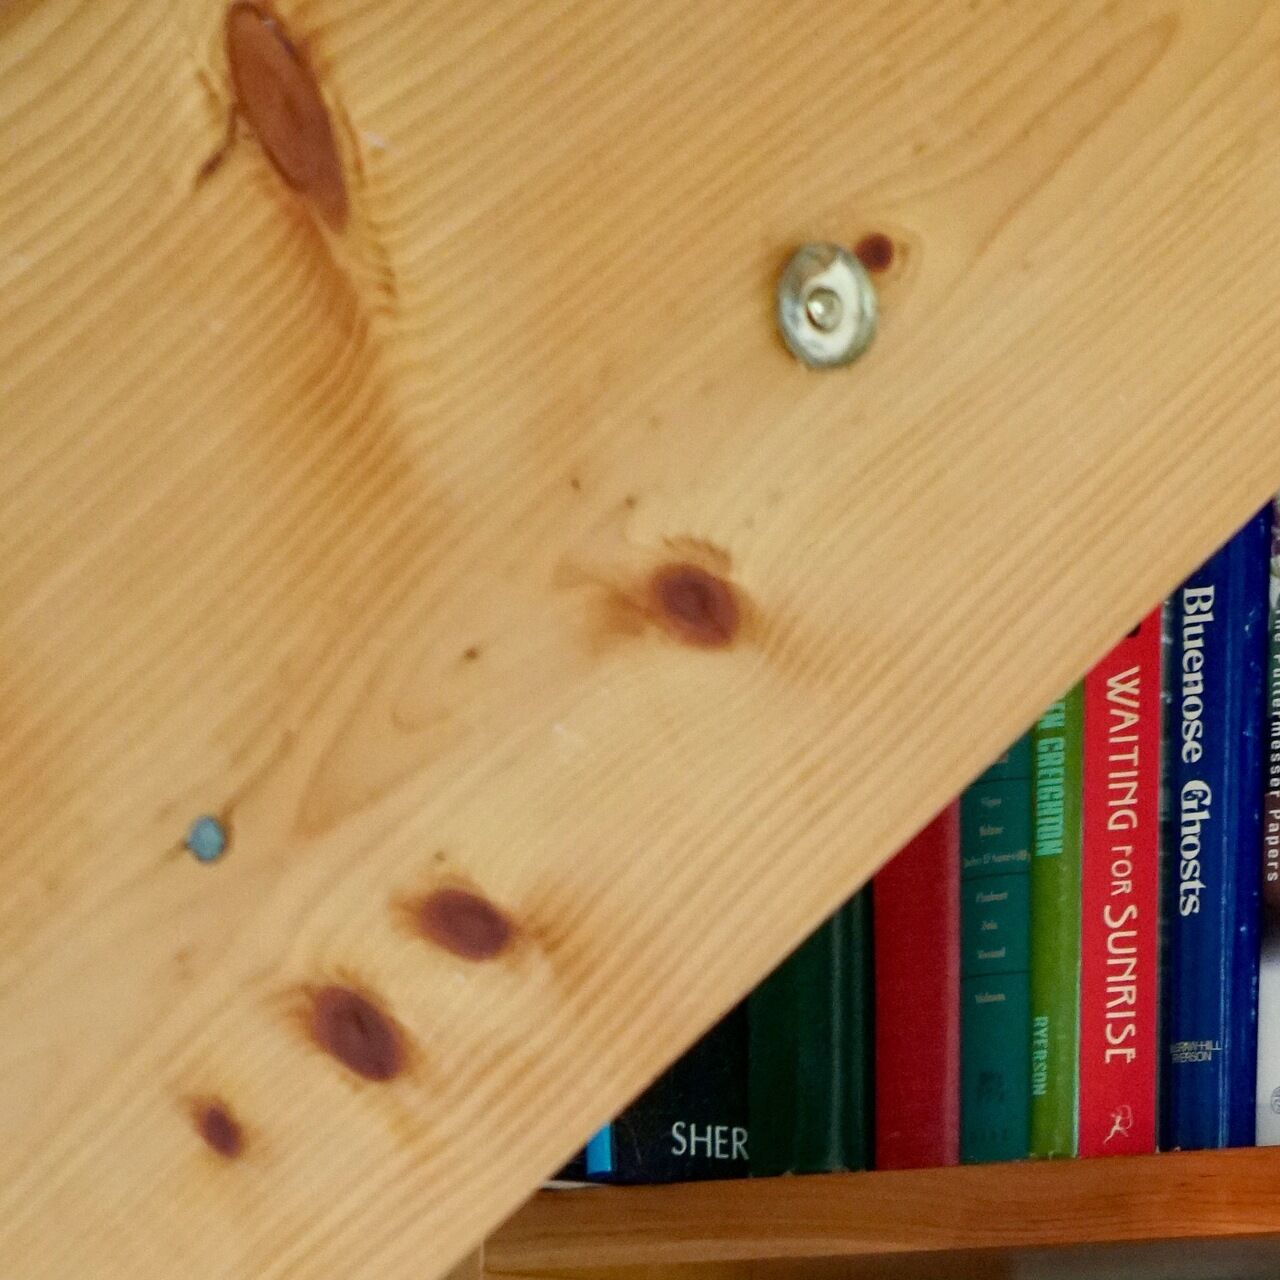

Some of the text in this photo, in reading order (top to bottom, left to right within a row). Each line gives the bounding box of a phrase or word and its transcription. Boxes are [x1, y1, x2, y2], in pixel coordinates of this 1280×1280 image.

[1104, 665, 1141, 1065] WAITING FOR SUNRISE
[1180, 584, 1214, 917] Bluenose Ghosts
